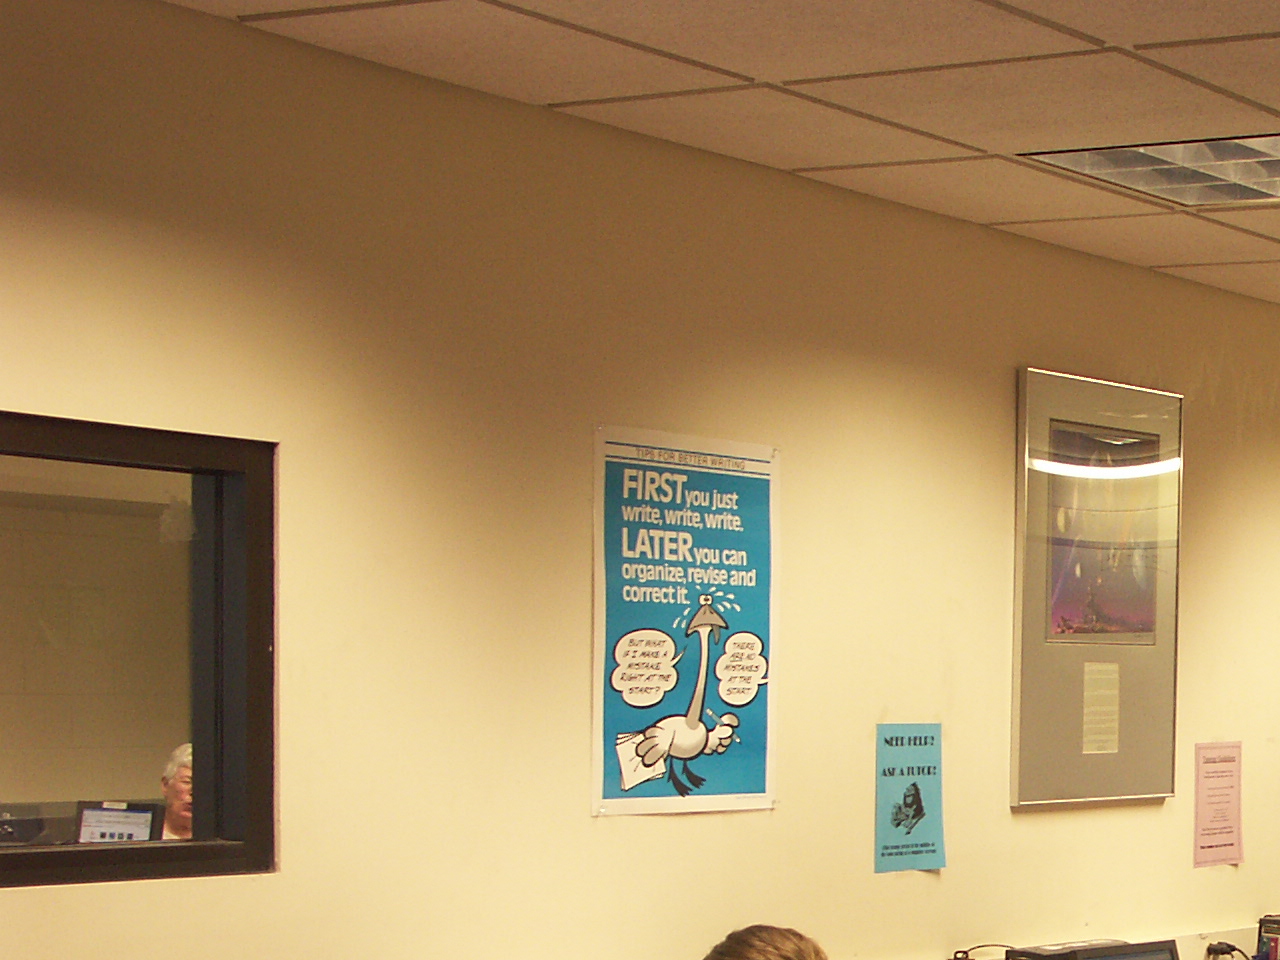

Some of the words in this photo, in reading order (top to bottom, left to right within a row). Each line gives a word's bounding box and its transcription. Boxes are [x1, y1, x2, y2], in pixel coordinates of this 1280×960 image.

[636, 448, 655, 458] TIPS
[658, 451, 675, 461] FOR
[678, 453, 708, 465] BETTER
[710, 456, 746, 470] WRITING
[622, 468, 687, 504] FIRST
[685, 490, 709, 508] you
[712, 489, 738, 510] just
[622, 504, 663, 526] write,
[665, 508, 703, 529] write,
[705, 512, 744, 532] write.
[622, 527, 693, 562] LATER
[693, 547, 720, 565] you
[722, 550, 747, 566] can
[622, 563, 687, 585] organize,
[688, 566, 728, 584] revise
[729, 568, 756, 587] and
[622, 585, 675, 603] correct
[676, 585, 690, 604] it.
[884, 736, 904, 747] NEED
[908, 735, 935, 747] HELP?
[882, 767, 896, 777] ASK
[899, 767, 905, 777] A
